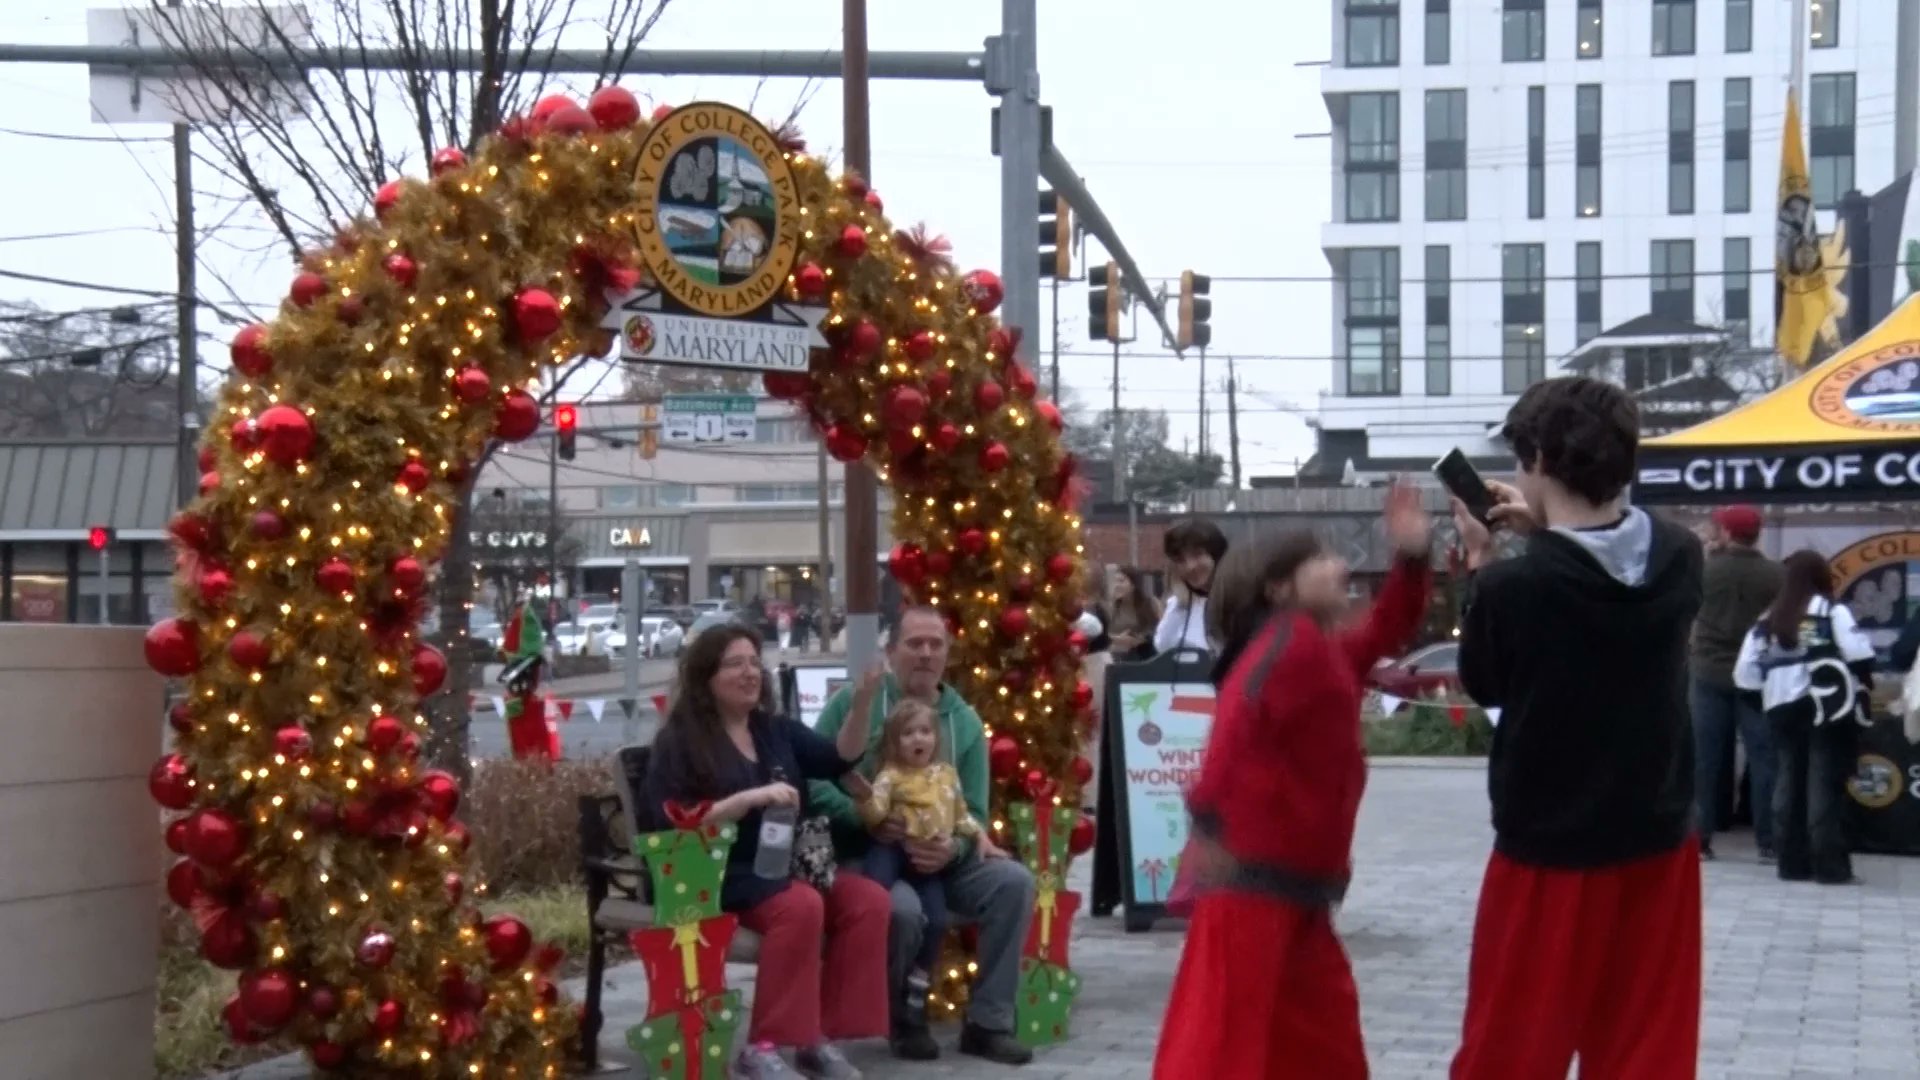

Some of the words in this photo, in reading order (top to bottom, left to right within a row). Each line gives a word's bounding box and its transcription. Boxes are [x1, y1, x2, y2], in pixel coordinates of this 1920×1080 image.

[639, 169, 656, 234] CITY
[651, 131, 674, 163] OF
[680, 111, 780, 171] COLLEGE
[774, 176, 795, 249] PARK
[656, 259, 776, 312] MARYLAND
[664, 318, 779, 341] UNIVERSITY
[786, 328, 806, 342] OF
[664, 334, 808, 368] MARYLAND
[706, 419, 713, 437] 1
[1684, 457, 1785, 491] CITY
[1797, 454, 1862, 488] OF
[487, 531, 547, 547] GUYS
[610, 527, 651, 546] CAVA
[1158, 749, 1207, 764] WINT
